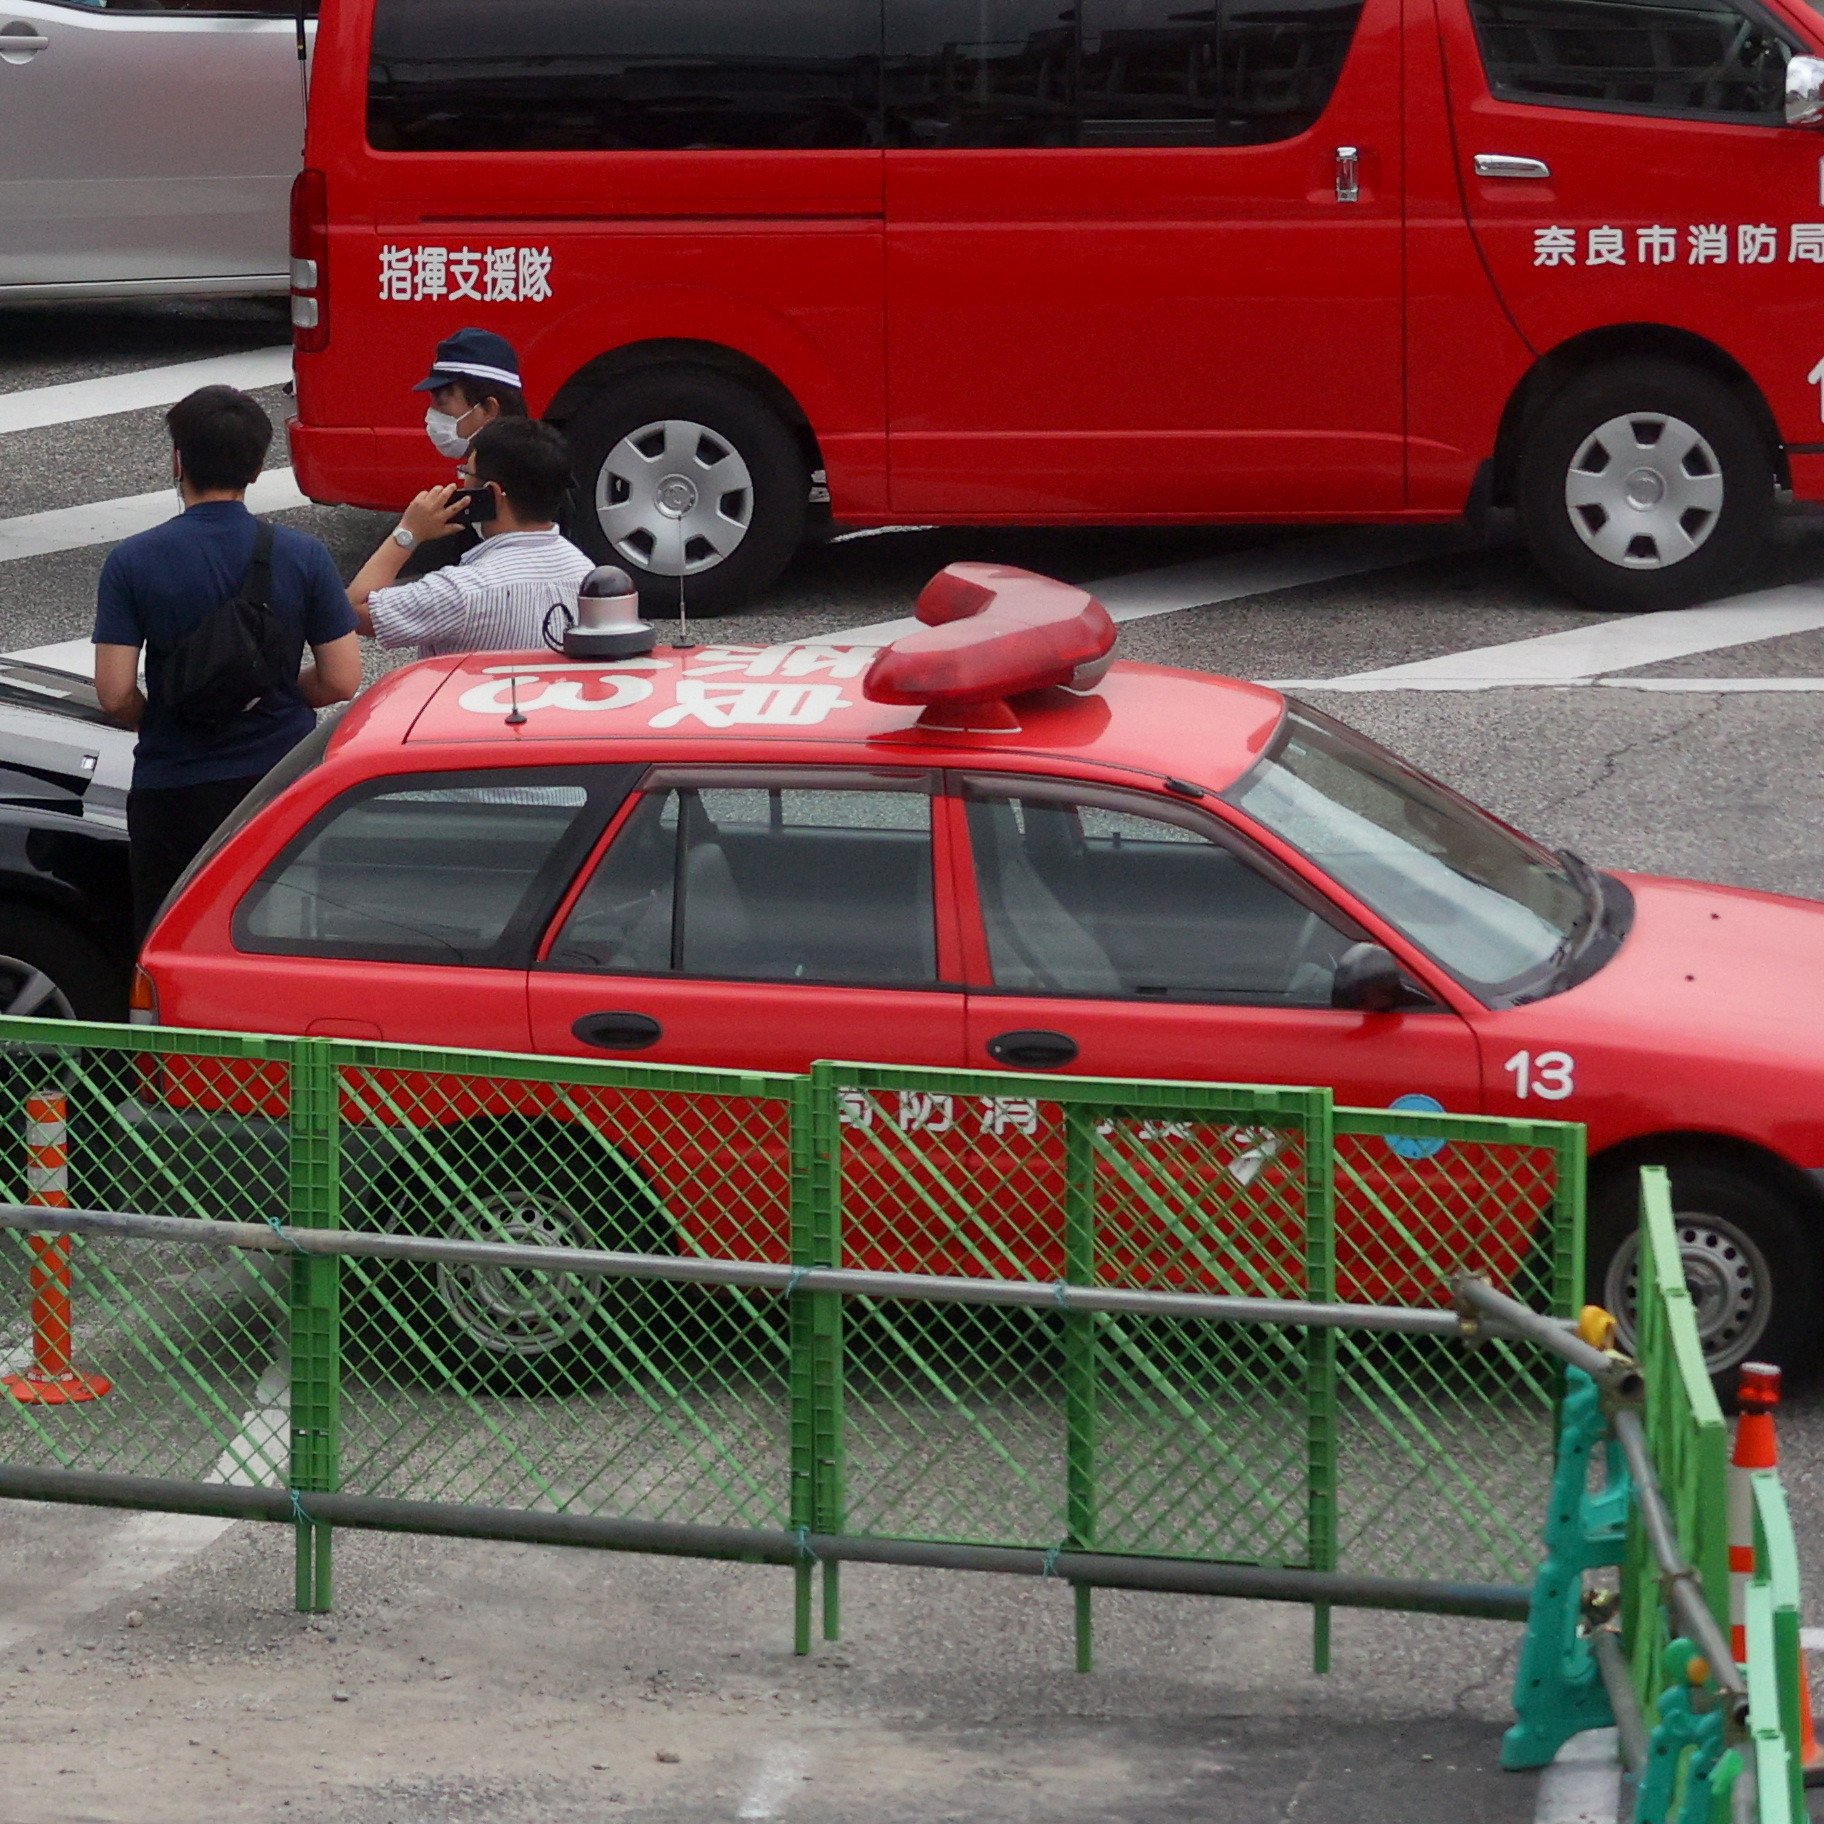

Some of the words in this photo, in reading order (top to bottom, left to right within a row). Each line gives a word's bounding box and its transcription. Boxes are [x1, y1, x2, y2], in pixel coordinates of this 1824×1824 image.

[1533, 223, 1824, 266] 奈良市消防局
[379, 244, 552, 302] 指揮支援隊
[1505, 1049, 1575, 1101] 13
